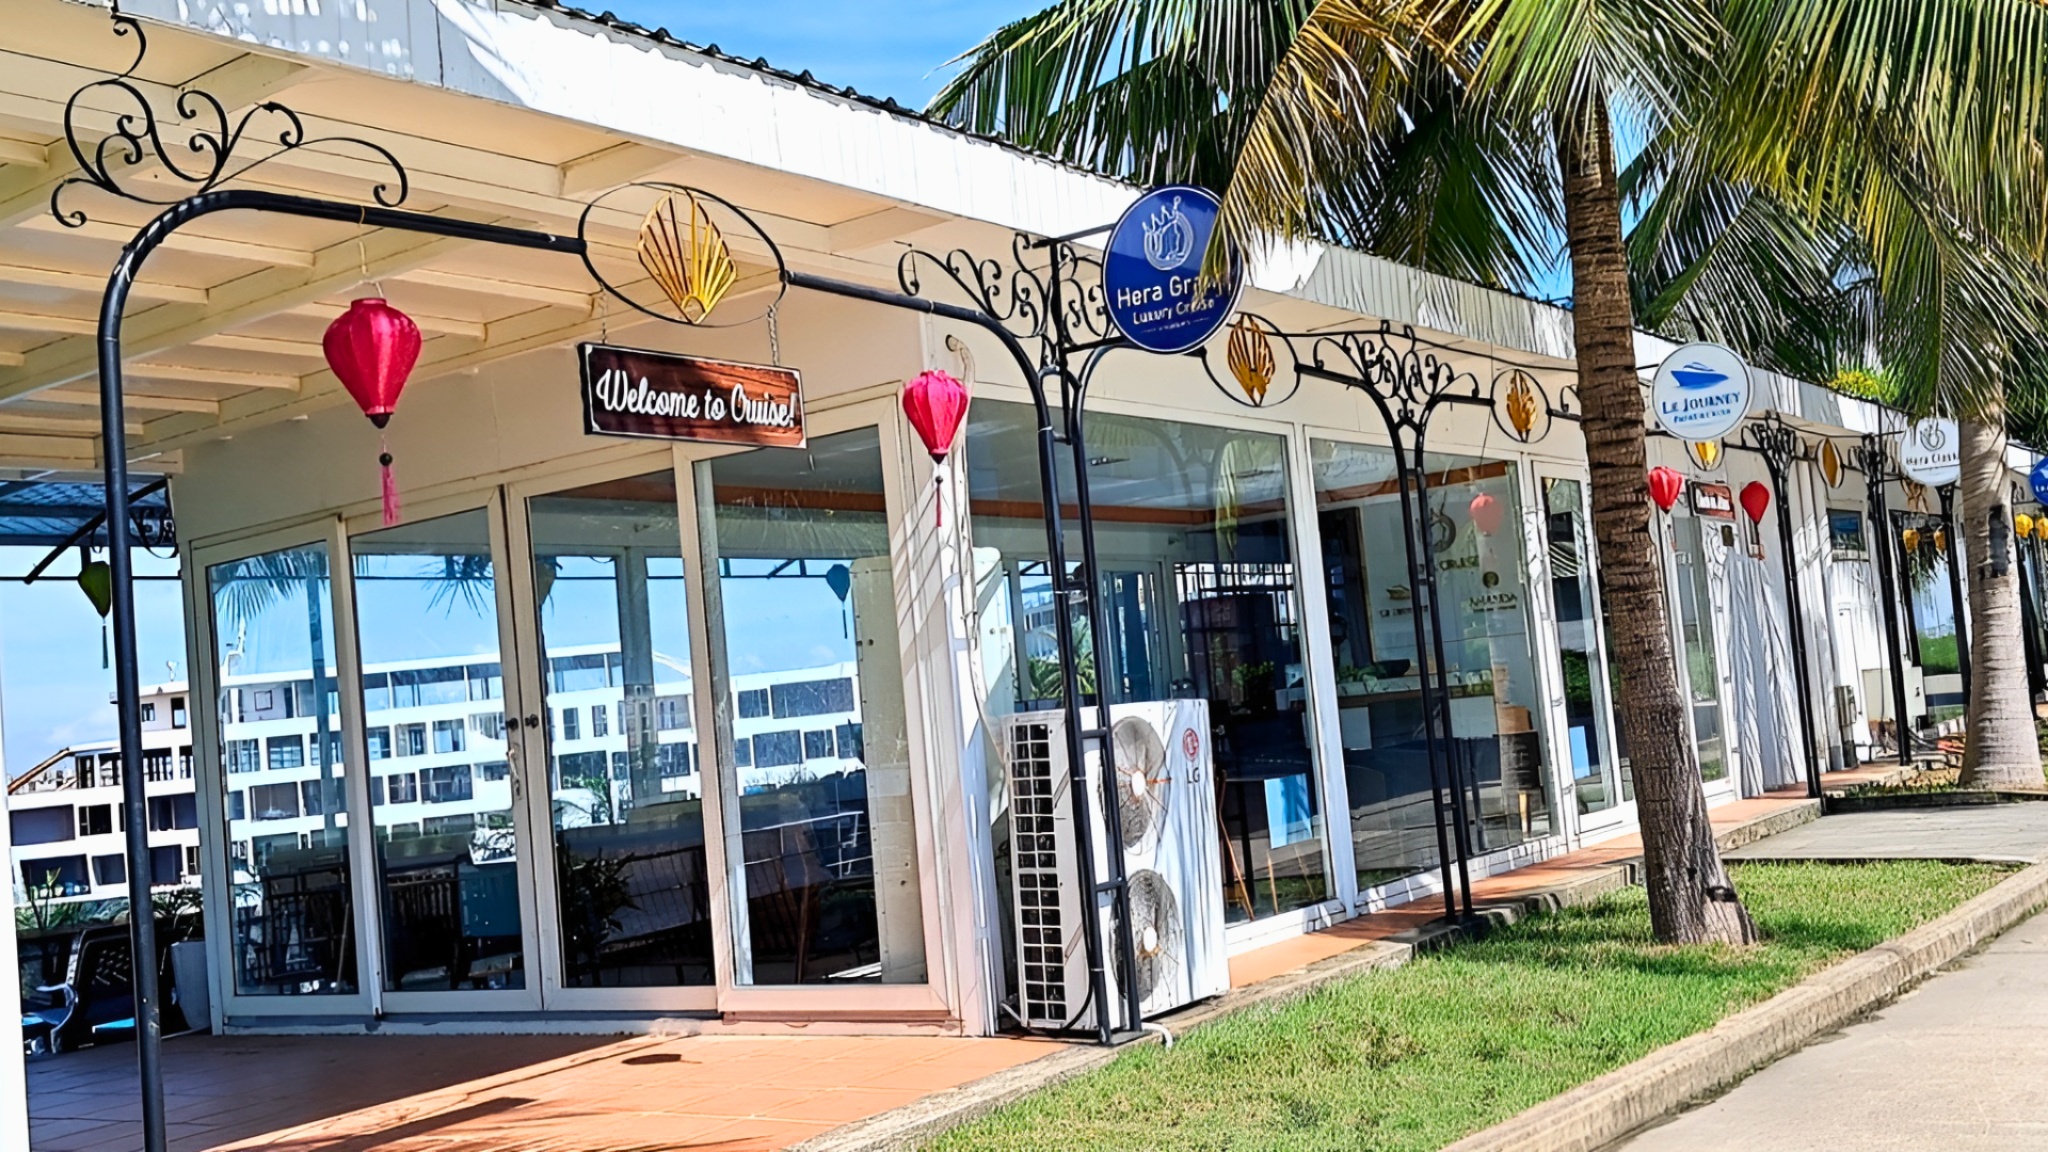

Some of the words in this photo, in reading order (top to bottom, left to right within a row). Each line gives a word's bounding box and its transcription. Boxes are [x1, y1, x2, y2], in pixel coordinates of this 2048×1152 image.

[1117, 284, 1164, 310] Hera
[1133, 306, 1173, 325] Luxury
[596, 368, 701, 419] Welcome
[704, 388, 728, 421] to
[731, 382, 799, 428] Cruise!
[1185, 766, 1201, 784] LG
